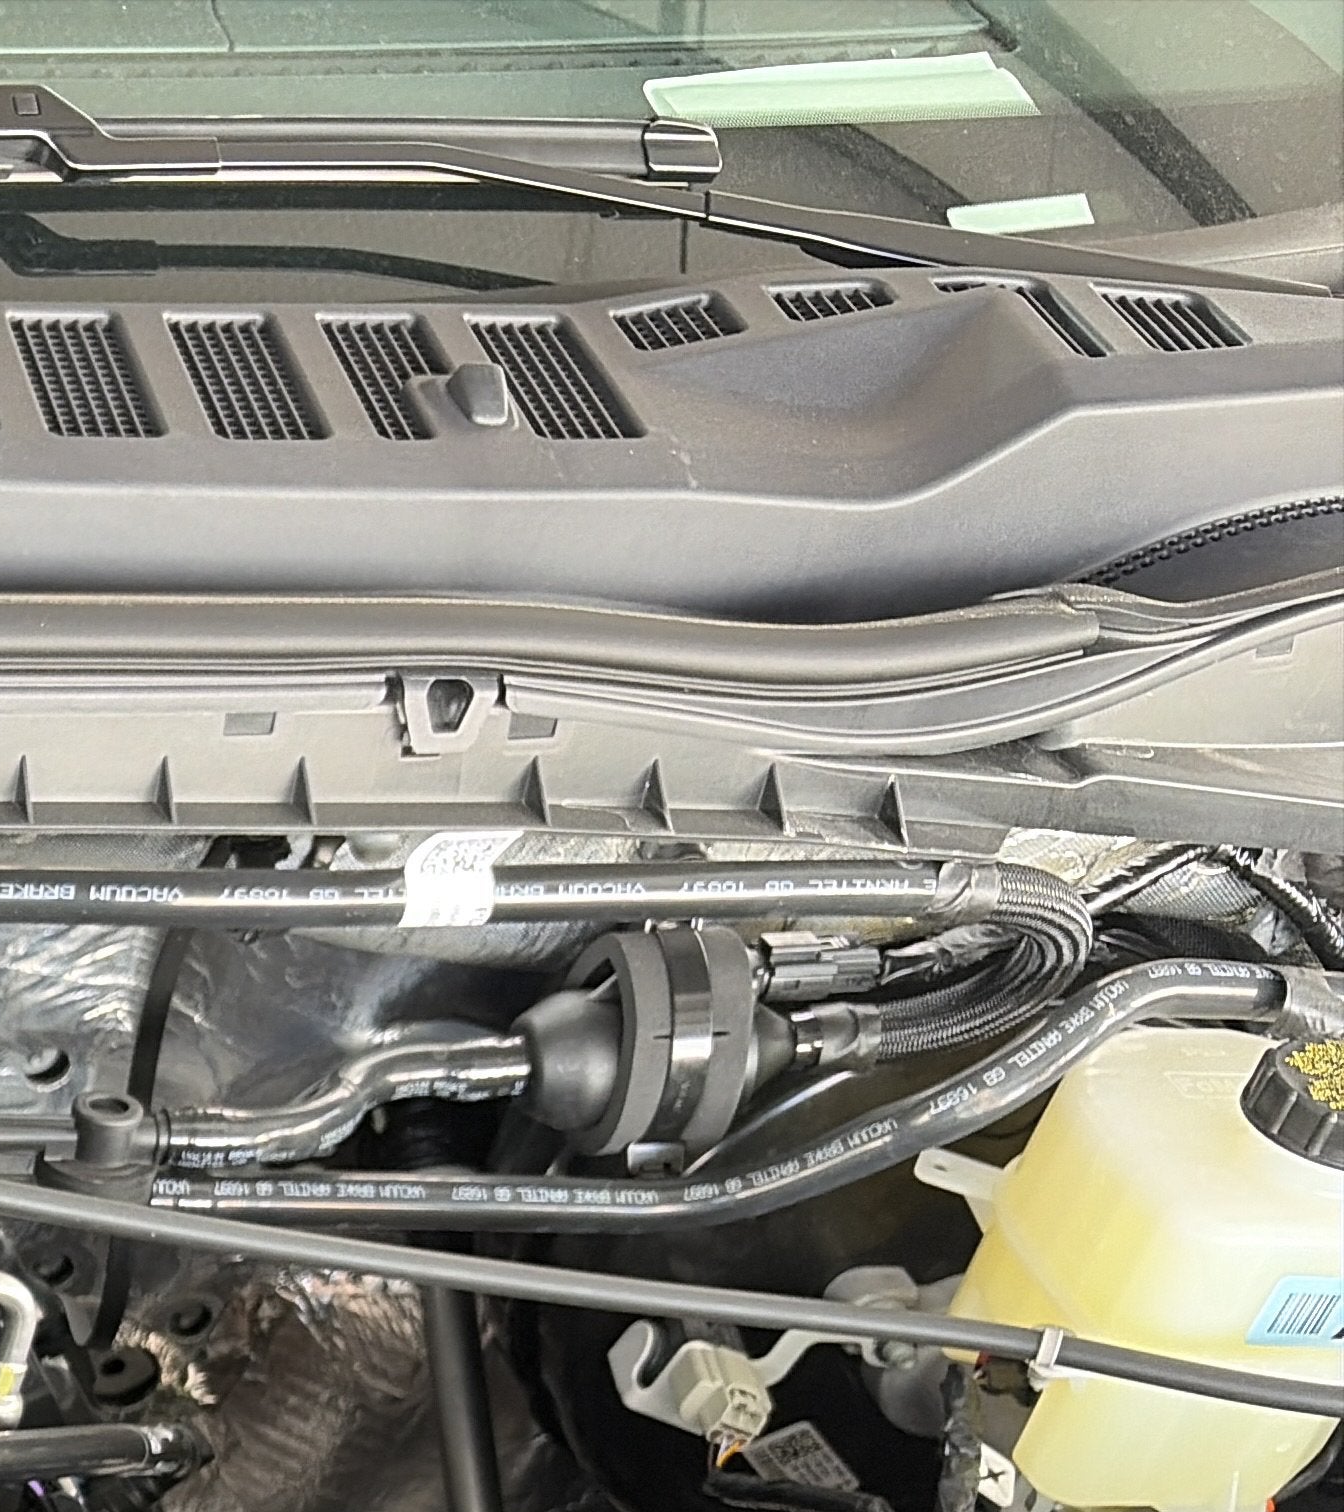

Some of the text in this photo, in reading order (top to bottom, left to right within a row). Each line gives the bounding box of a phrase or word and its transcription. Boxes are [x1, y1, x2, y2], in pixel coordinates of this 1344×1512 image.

[0, 883, 76, 901] BRAKE
[89, 884, 184, 904] VACUUM
[982, 1067, 1006, 1094] GB
[929, 1079, 978, 1116] 16897
